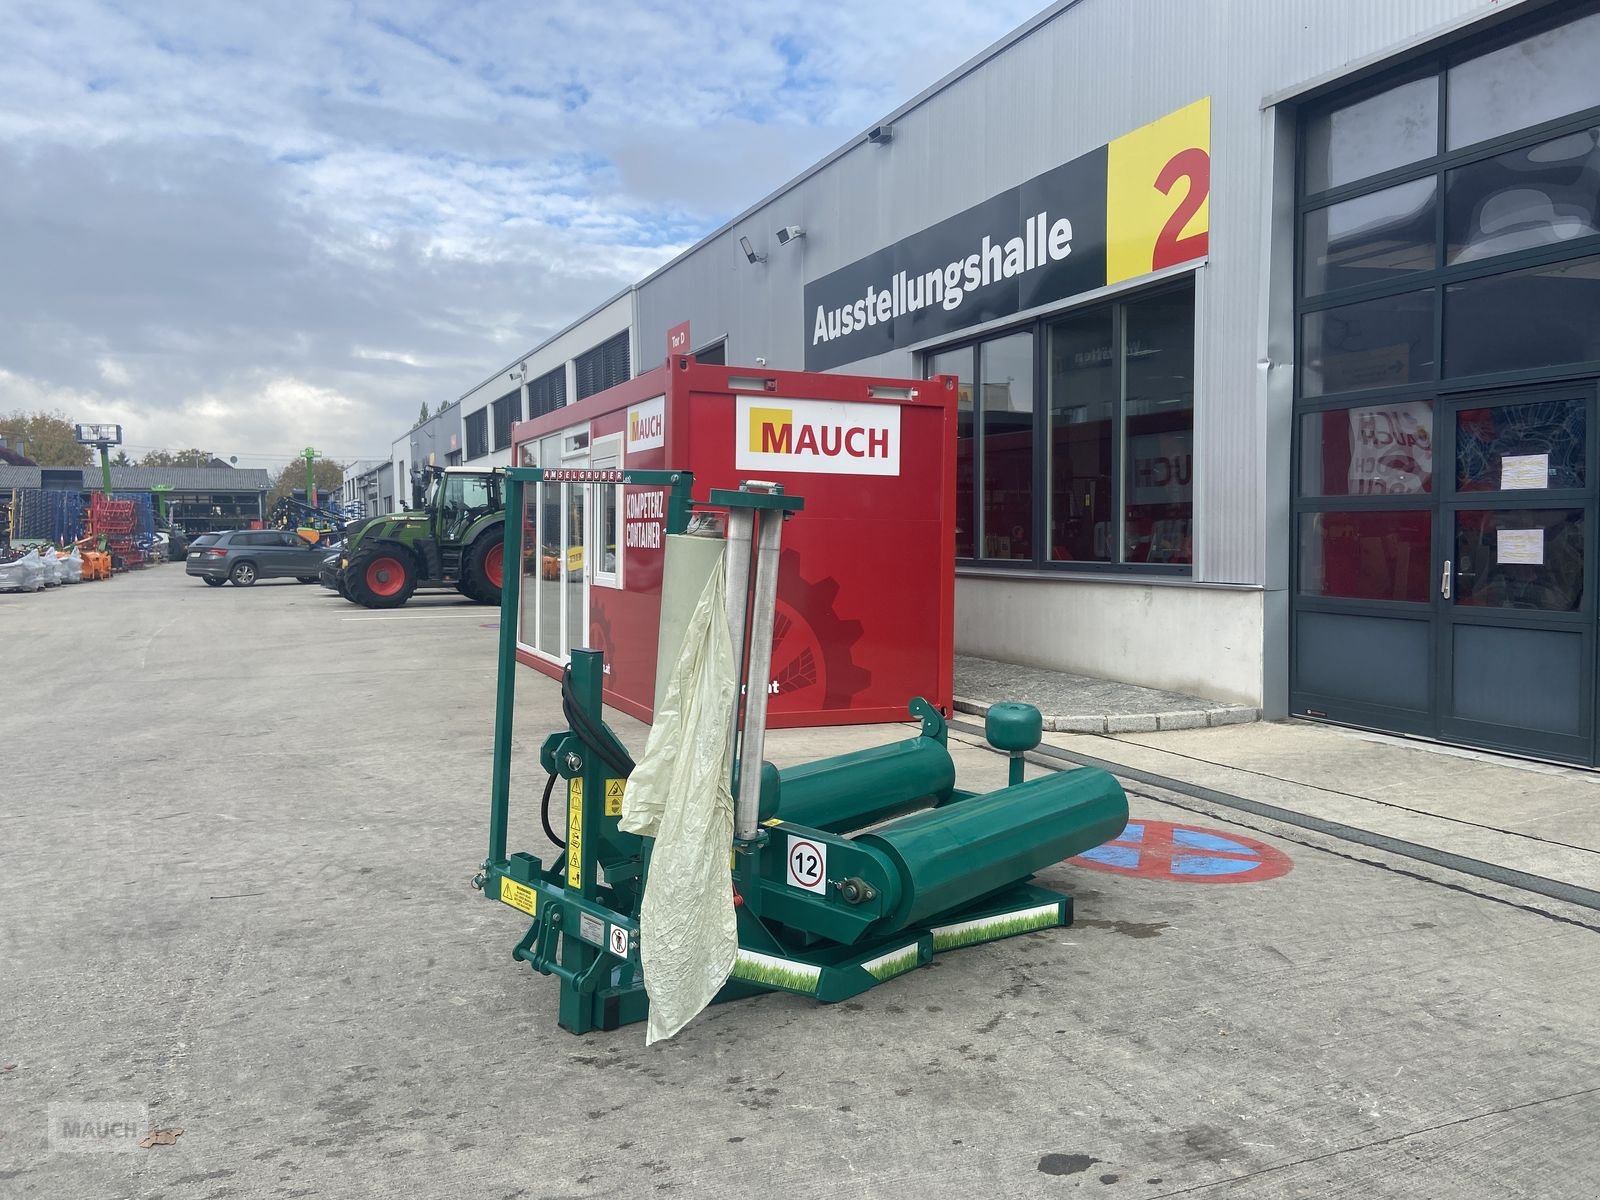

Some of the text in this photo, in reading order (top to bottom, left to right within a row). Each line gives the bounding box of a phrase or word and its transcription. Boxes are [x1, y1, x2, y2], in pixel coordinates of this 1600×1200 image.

[812, 147, 1210, 346] Ausstellungshalle 2
[671, 331, 685, 349] Tor D
[632, 413, 662, 443] MAUCH
[762, 422, 889, 459] MAUCH
[544, 470, 623, 482] AMSELGRUBER
[626, 491, 664, 519] KOMPETENZ
[626, 522, 661, 549] CONTAINER
[794, 851, 818, 878] 12
